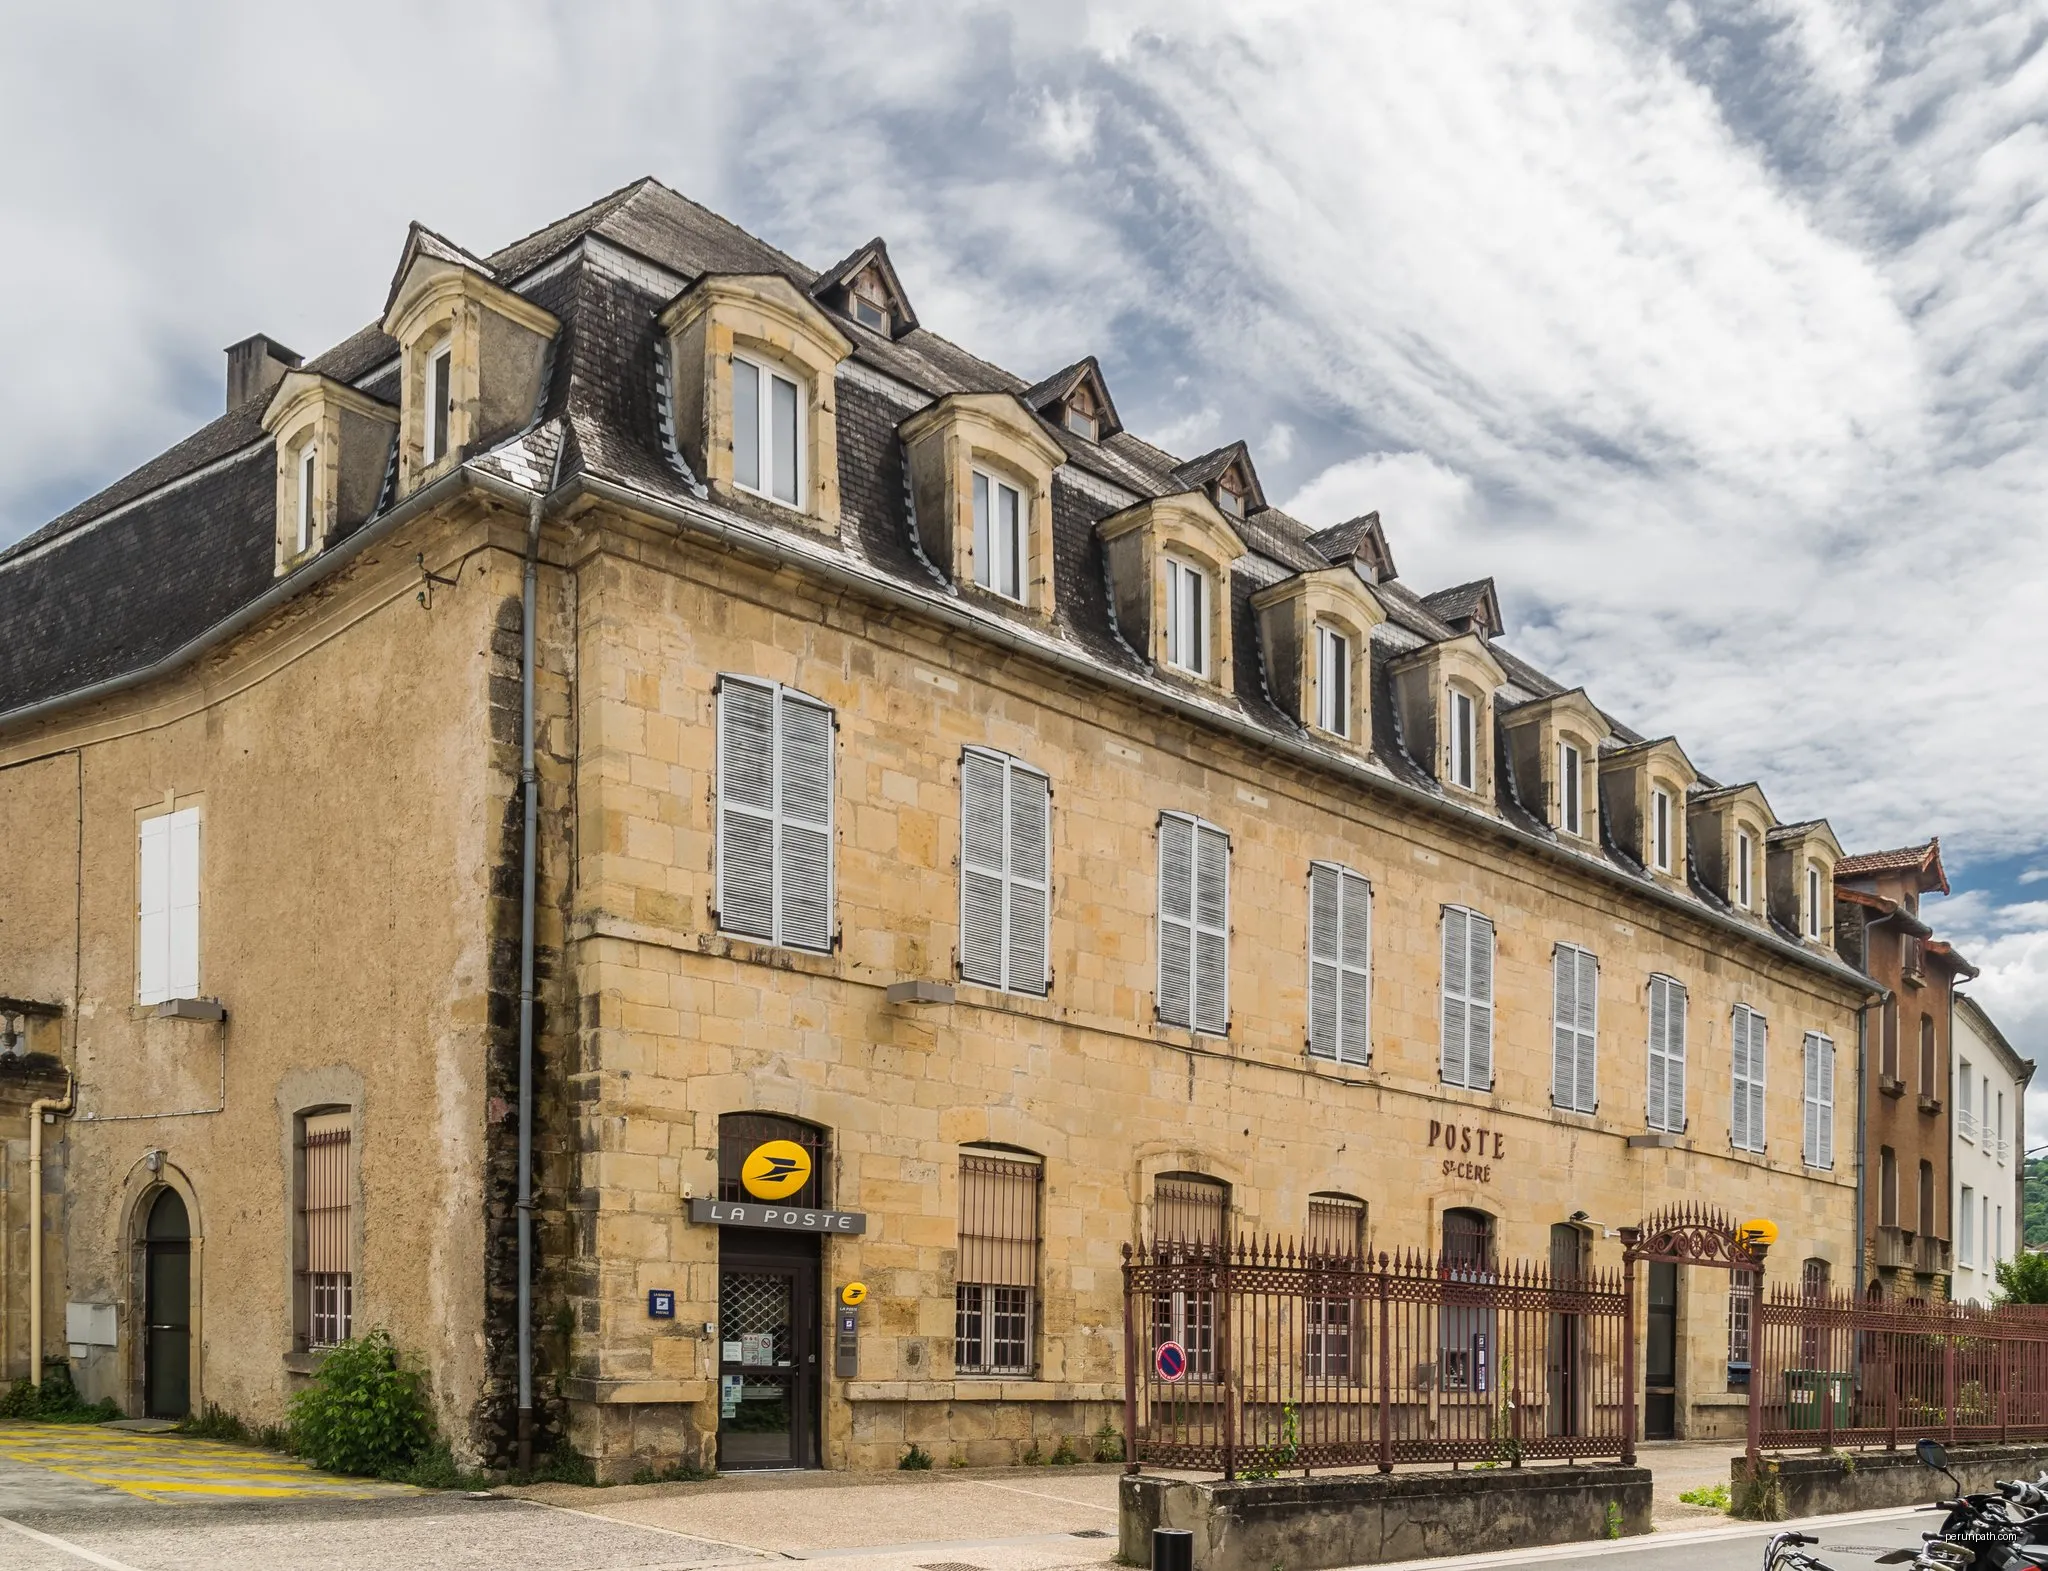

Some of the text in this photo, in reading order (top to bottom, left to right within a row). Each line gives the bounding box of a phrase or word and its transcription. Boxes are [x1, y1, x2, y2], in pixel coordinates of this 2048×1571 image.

[1428, 1119, 1505, 1160] POSTE
[1457, 1161, 1491, 1183] CÉRÉ
[710, 1205, 852, 1229] LA POSTE
